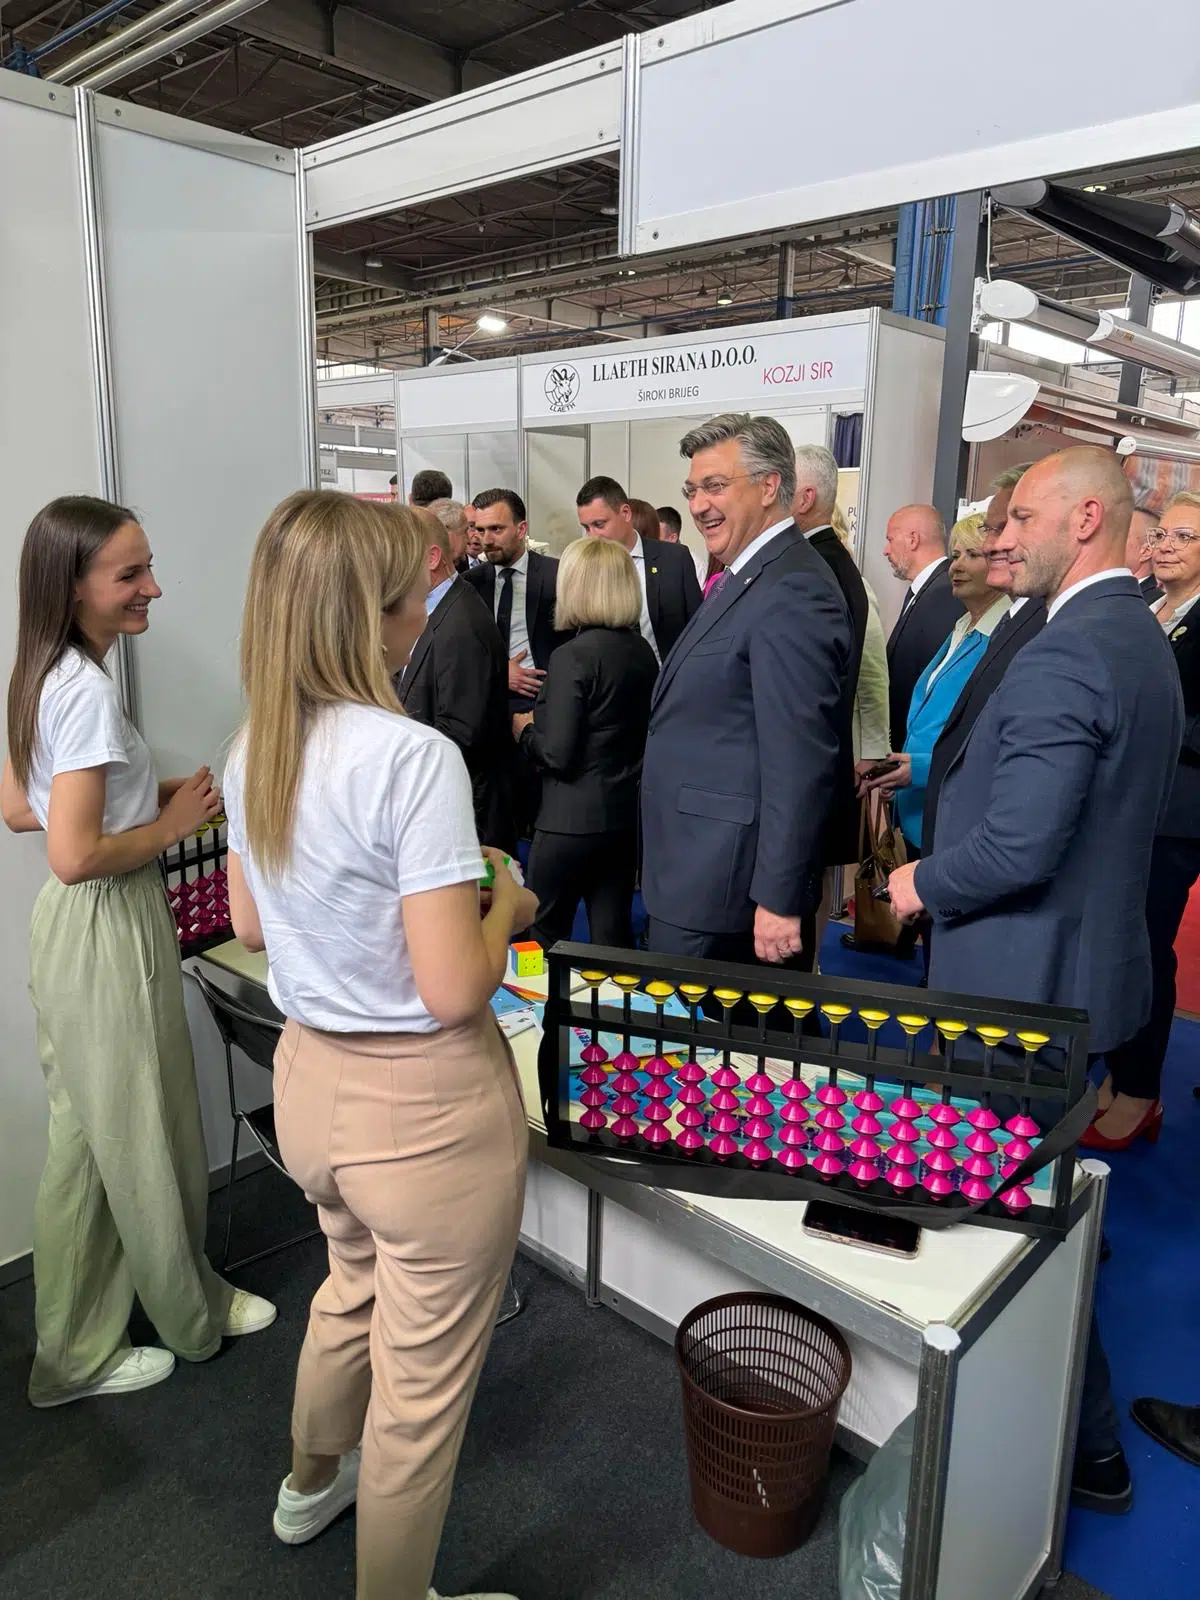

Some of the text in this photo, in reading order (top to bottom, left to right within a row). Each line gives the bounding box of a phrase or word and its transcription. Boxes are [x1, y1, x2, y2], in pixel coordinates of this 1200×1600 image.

[593, 345, 758, 382] LLAETH SIRANA D.O.O.
[763, 361, 833, 385] KOZJI SIR
[638, 385, 699, 402] ŠIROKI BRIJEG
[550, 402, 576, 413] LLAETH
